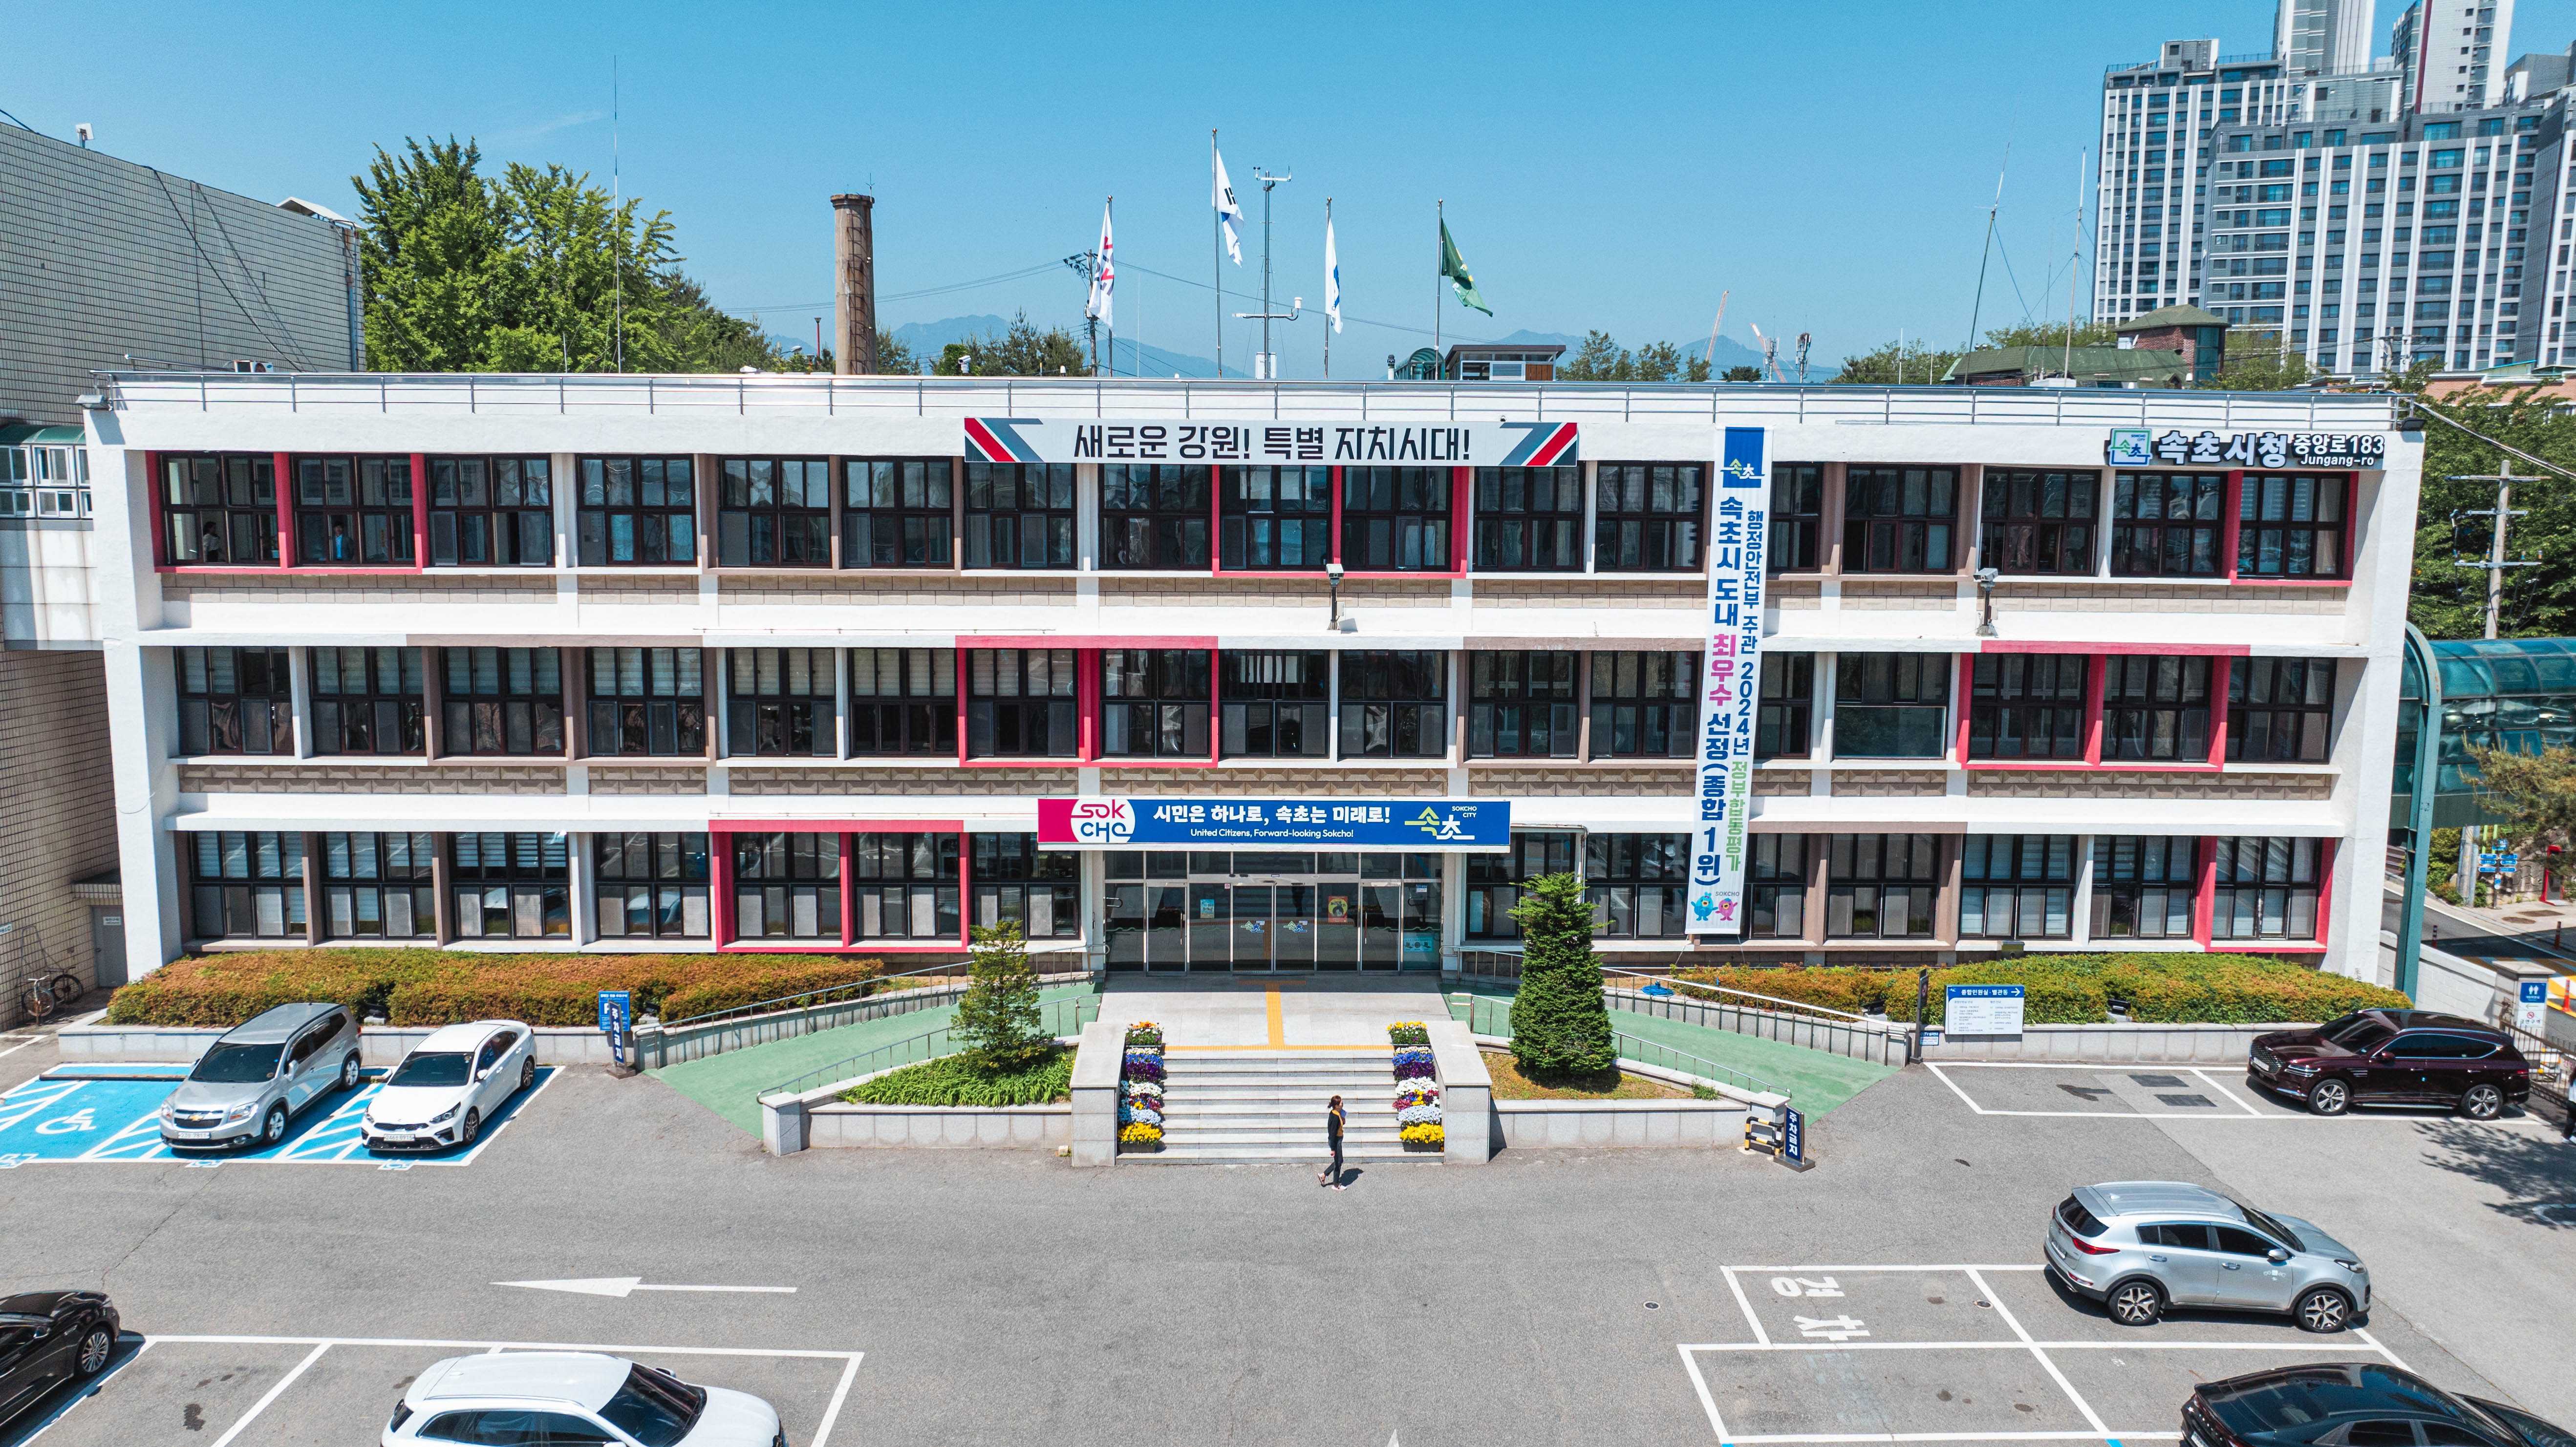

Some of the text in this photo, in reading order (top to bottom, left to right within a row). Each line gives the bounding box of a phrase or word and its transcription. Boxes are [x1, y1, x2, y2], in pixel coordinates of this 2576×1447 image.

[1074, 425, 1470, 461] 새로운 강원! 특별 자치시대!
[2158, 430, 2288, 468] 속초시청
[2300, 454, 2375, 467] Jungang-ro
[1717, 496, 1743, 571] 속초시
[1714, 578, 1739, 626] 도내
[1709, 634, 1736, 706] 최우수
[1725, 510, 1763, 872] 행정안전부 주관 2024년 정부합동평가
[1153, 805, 1390, 826] 시민은 하나로, 속초는 미래로!
[1191, 829, 1218, 837] United
[1219, 829, 1252, 838] Citizens,
[1254, 829, 1321, 839] Forward-looking
[612, 1007, 623, 1060] 주차금지
[1789, 1111, 1798, 1156] 주차금지
[1771, 1276, 1871, 1341] 경차
